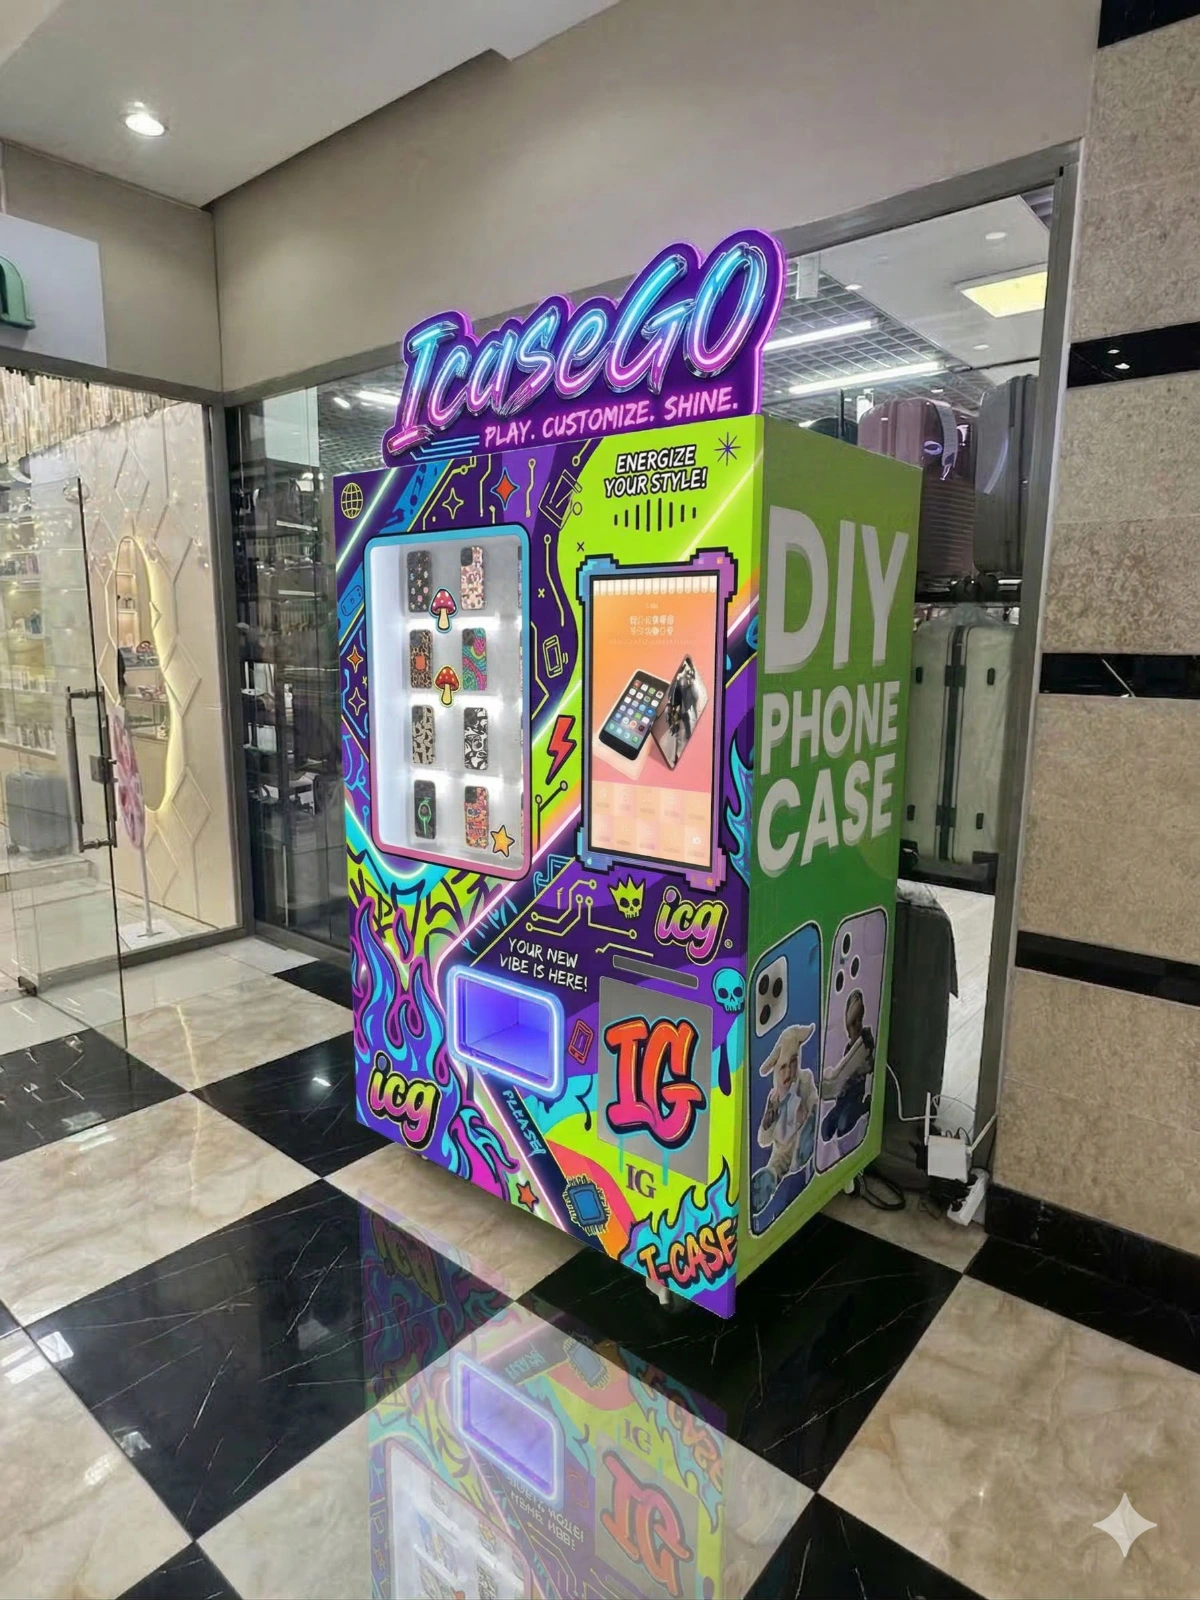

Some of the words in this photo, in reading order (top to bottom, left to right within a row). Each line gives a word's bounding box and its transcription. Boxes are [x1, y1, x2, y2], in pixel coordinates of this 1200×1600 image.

[386, 242, 768, 456] IcaseGO
[484, 421, 535, 448] PLAY.
[542, 400, 655, 438] CUSTOMIZE.
[664, 386, 738, 420] SHINE.
[604, 474, 648, 498] YOUR
[651, 466, 708, 491] STYLE!
[616, 445, 696, 474] ENERGIZE
[764, 505, 909, 674] DIY
[760, 680, 900, 776] PHONE
[757, 753, 896, 878] CASE
[508, 937, 542, 963] YOUR
[547, 948, 579, 969] NEW
[655, 887, 726, 963] icg
[499, 953, 529, 974] VIBE
[533, 962, 545, 979] IS
[548, 967, 588, 993] HERE!
[368, 1052, 439, 1148] icg
[604, 1017, 706, 1147] IG
[625, 1164, 657, 1200] IG
